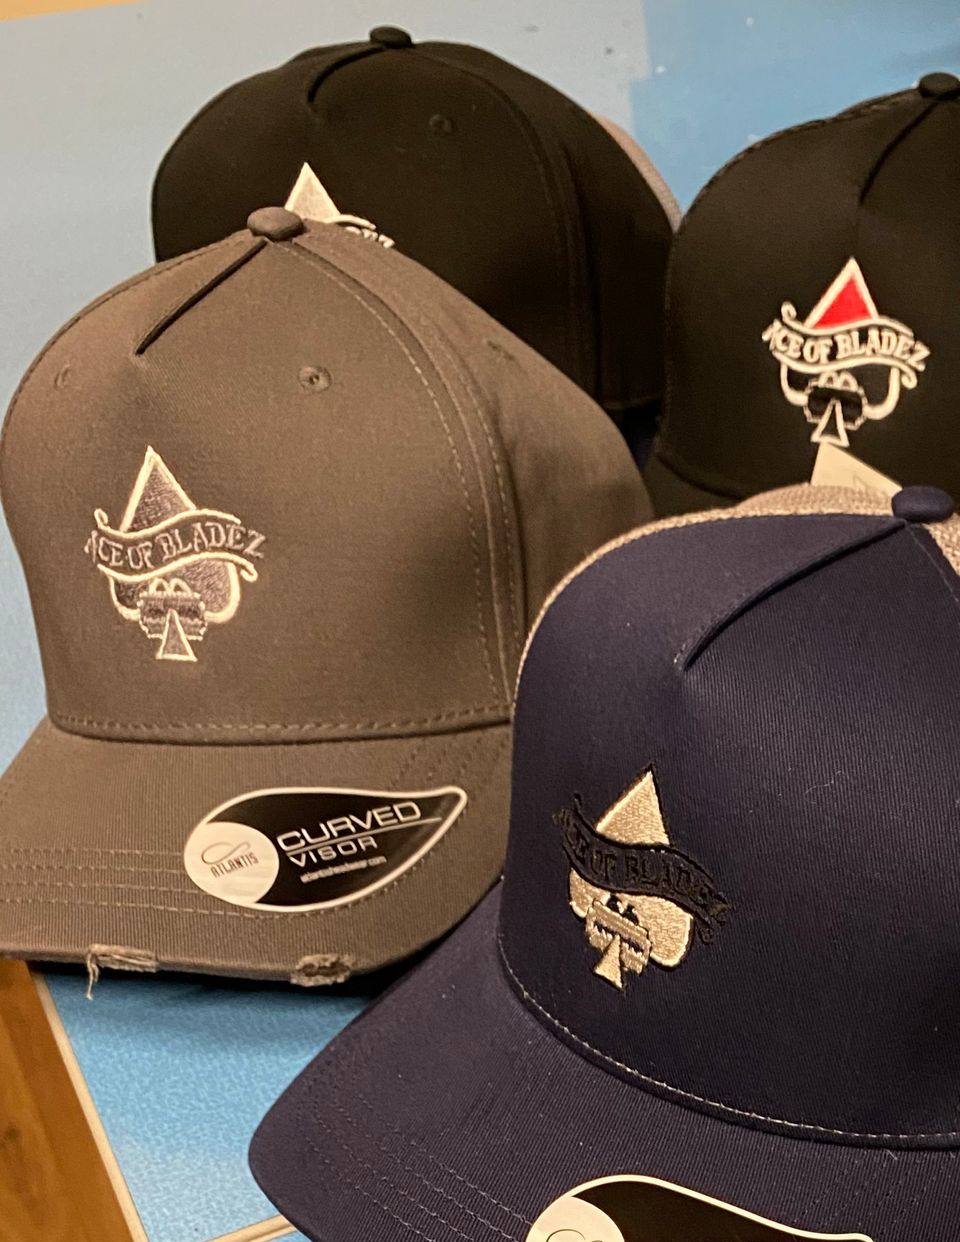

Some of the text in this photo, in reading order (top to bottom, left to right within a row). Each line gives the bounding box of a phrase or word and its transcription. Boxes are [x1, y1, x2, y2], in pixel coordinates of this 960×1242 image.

[762, 319, 931, 372] ACE OF BLADEZ
[84, 522, 266, 569] ACE OF BLADEZ
[276, 801, 422, 851] CURVED
[210, 852, 259, 879] ATLANTIS
[289, 835, 378, 868] VISOR
